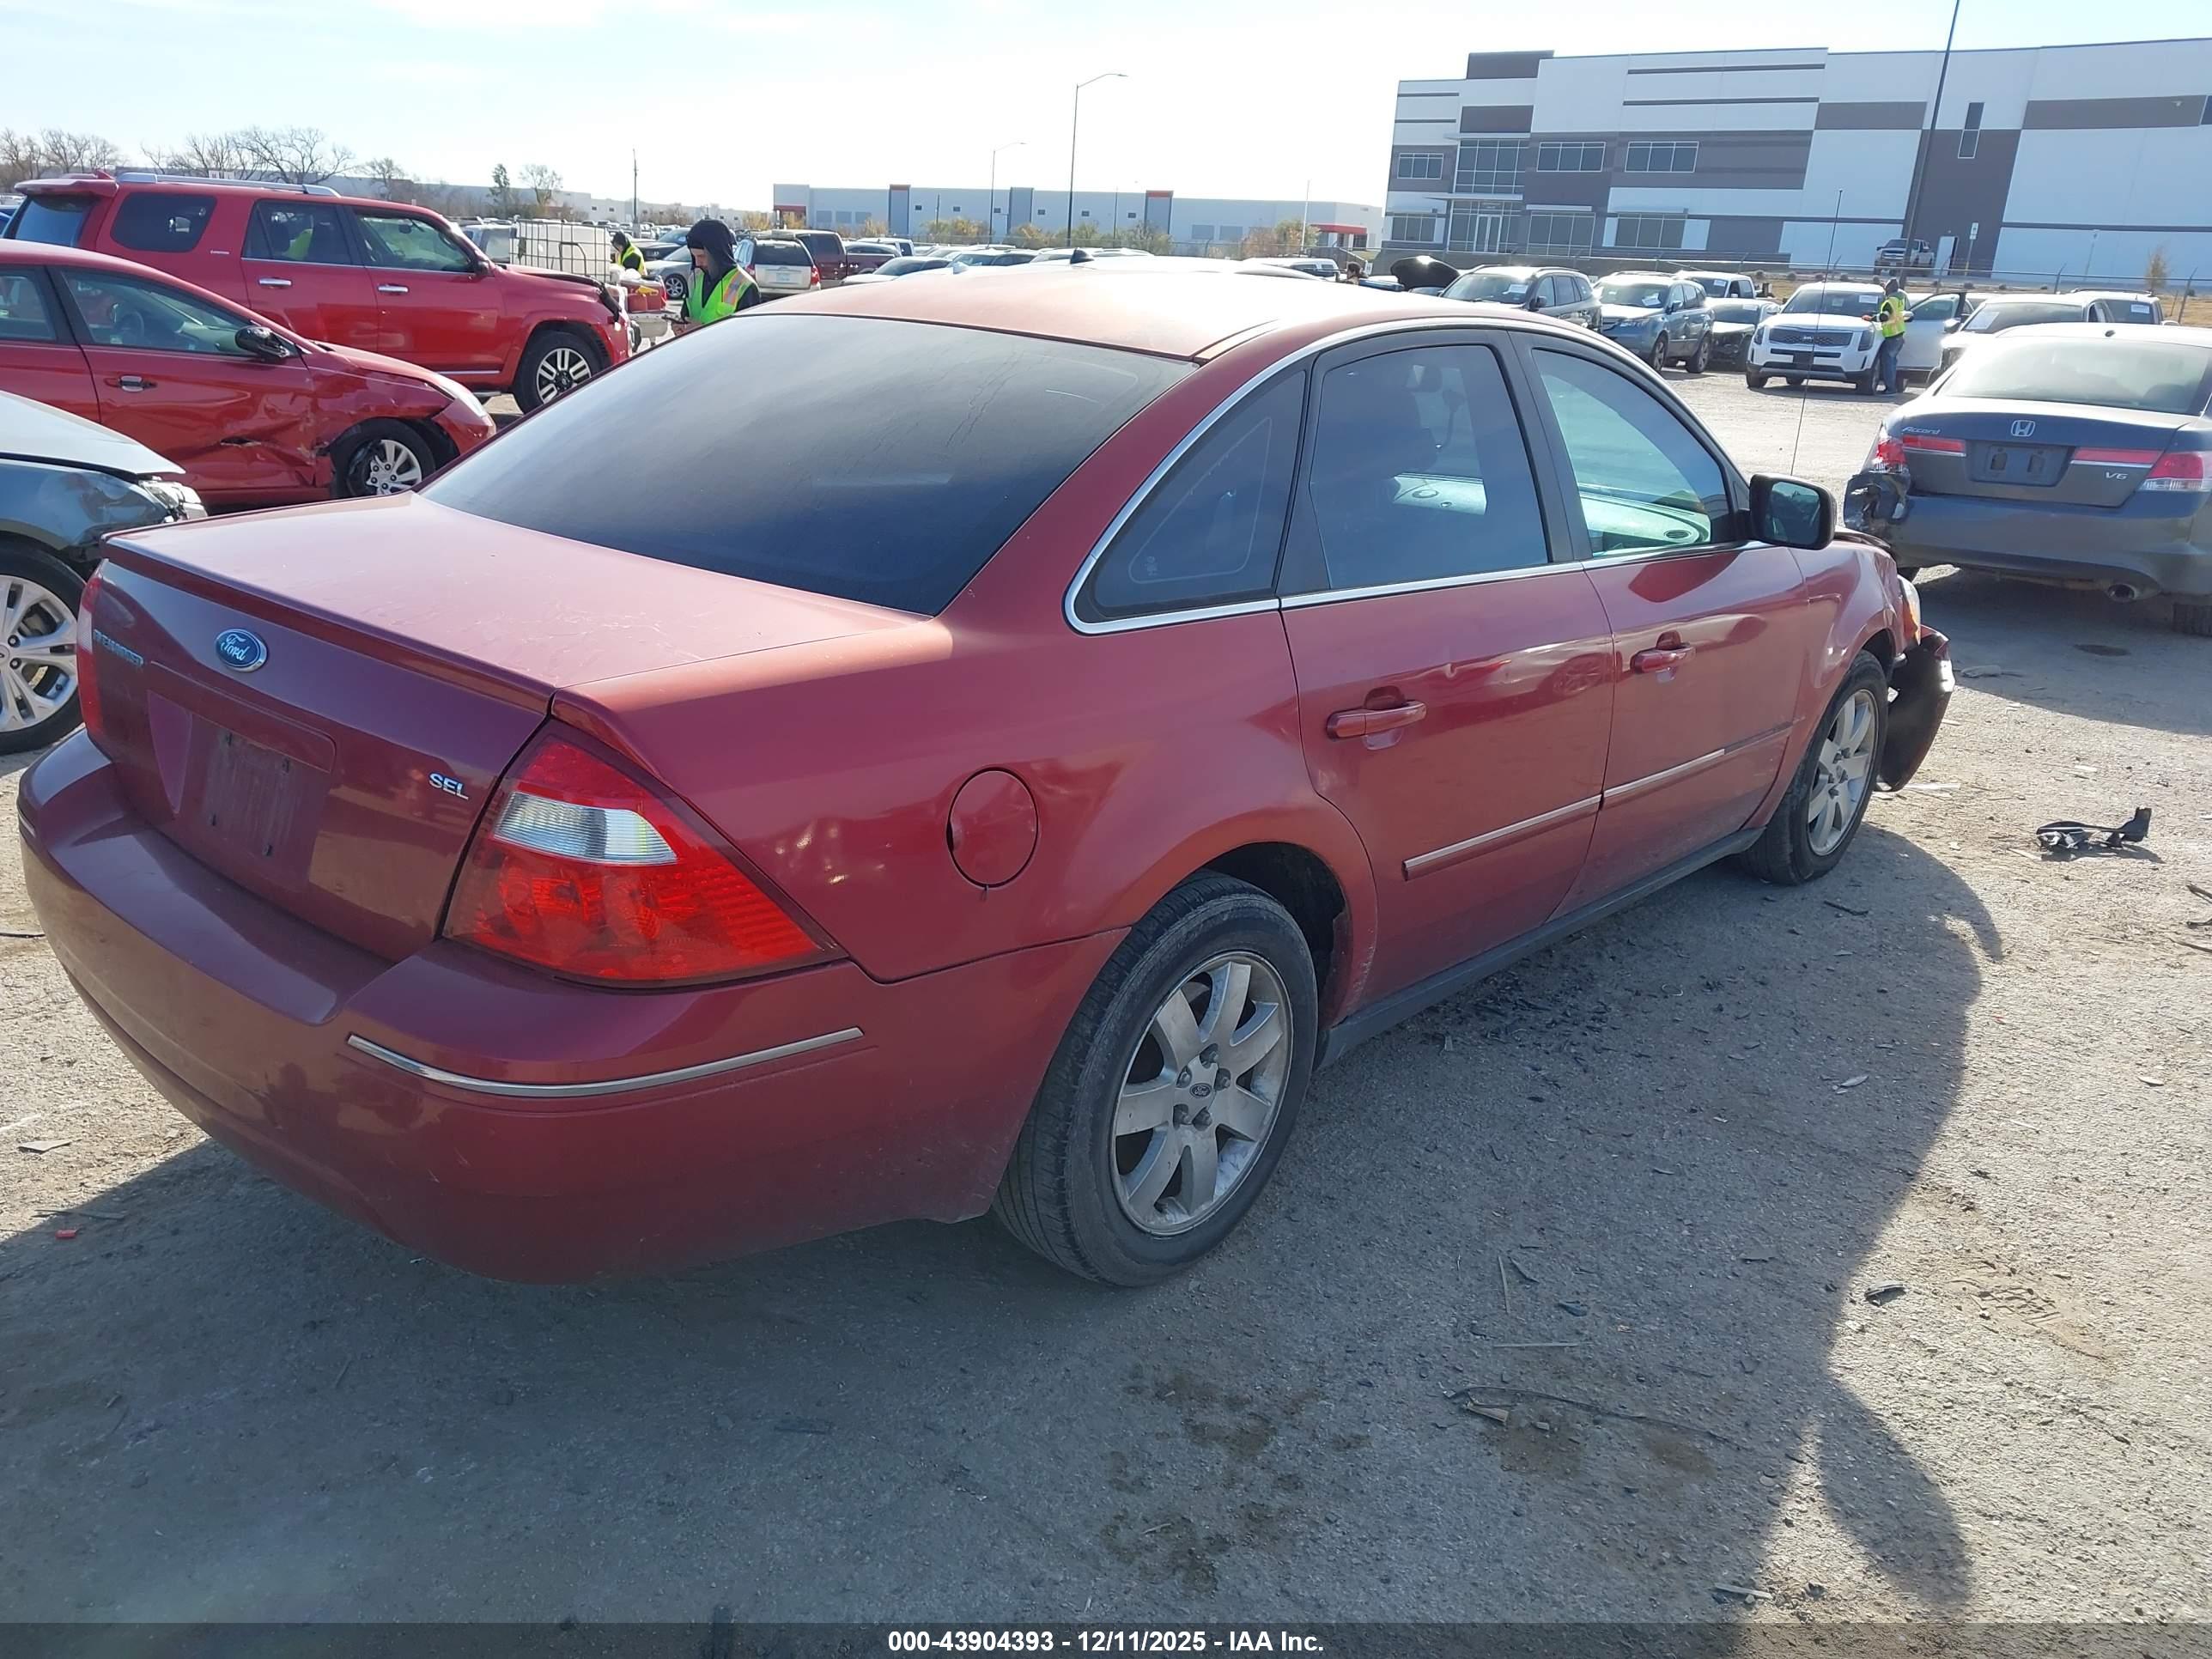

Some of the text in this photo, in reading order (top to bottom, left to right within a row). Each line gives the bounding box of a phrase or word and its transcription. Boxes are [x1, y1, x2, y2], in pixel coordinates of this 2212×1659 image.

[1902, 426, 1942, 434] Accord
[2106, 471, 2129, 480] V6
[220, 633, 251, 661] Ford
[428, 773, 469, 800] SEL
